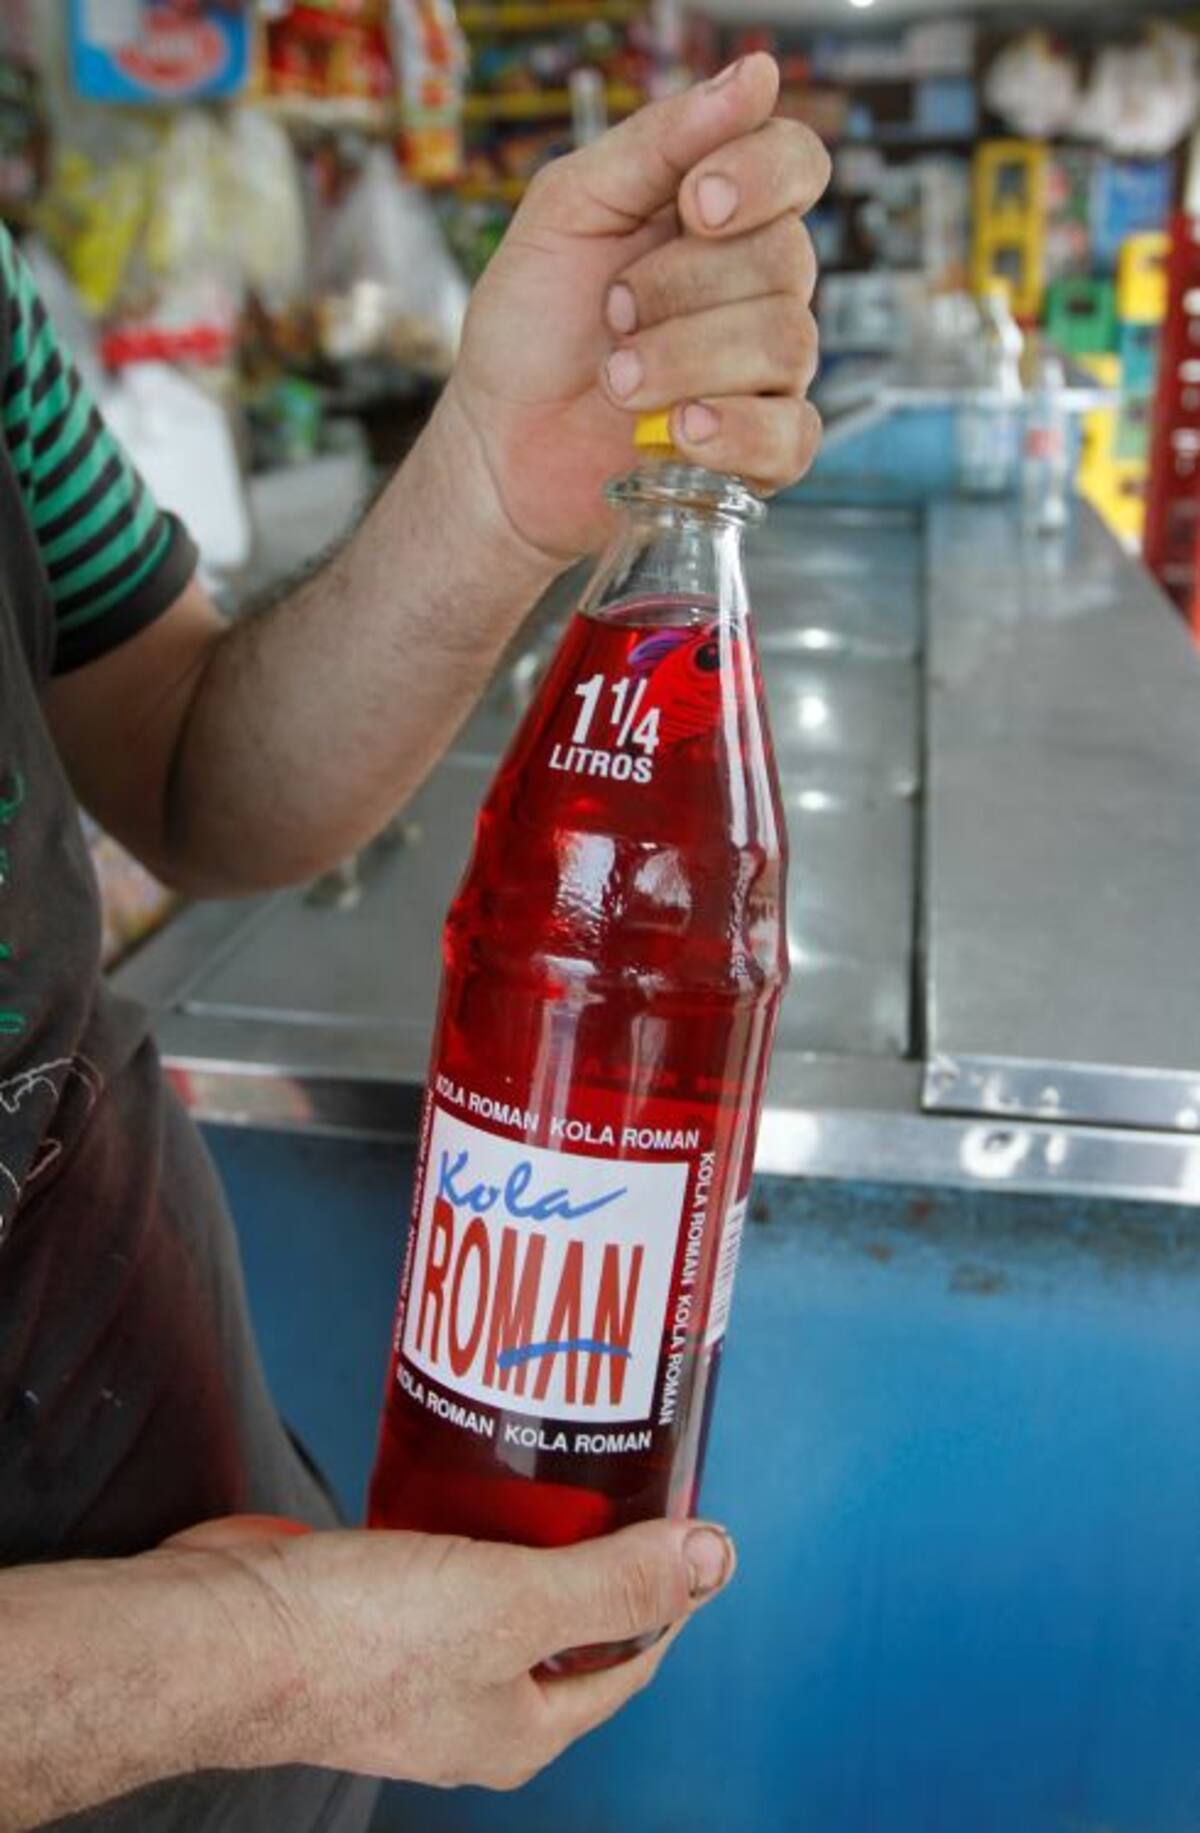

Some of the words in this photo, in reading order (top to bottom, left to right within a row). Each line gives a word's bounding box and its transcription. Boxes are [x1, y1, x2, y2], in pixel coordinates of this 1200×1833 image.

[548, 743, 653, 783] LITROS
[436, 1075, 465, 1106] KOLA
[468, 1092, 539, 1132] ROMAN
[550, 1116, 615, 1146] KOLA
[621, 1127, 700, 1149] ROMAN
[438, 1150, 628, 1221] Kola
[692, 1152, 716, 1208] KOLA
[680, 1212, 706, 1286] ROMAN
[415, 1195, 645, 1407] ROMAN
[670, 1295, 692, 1350] KOLA
[426, 1390, 495, 1437] ROMAN
[504, 1423, 568, 1452] KOLA
[574, 1430, 652, 1453] ROMAN
[658, 1353, 684, 1426] ROMAN
